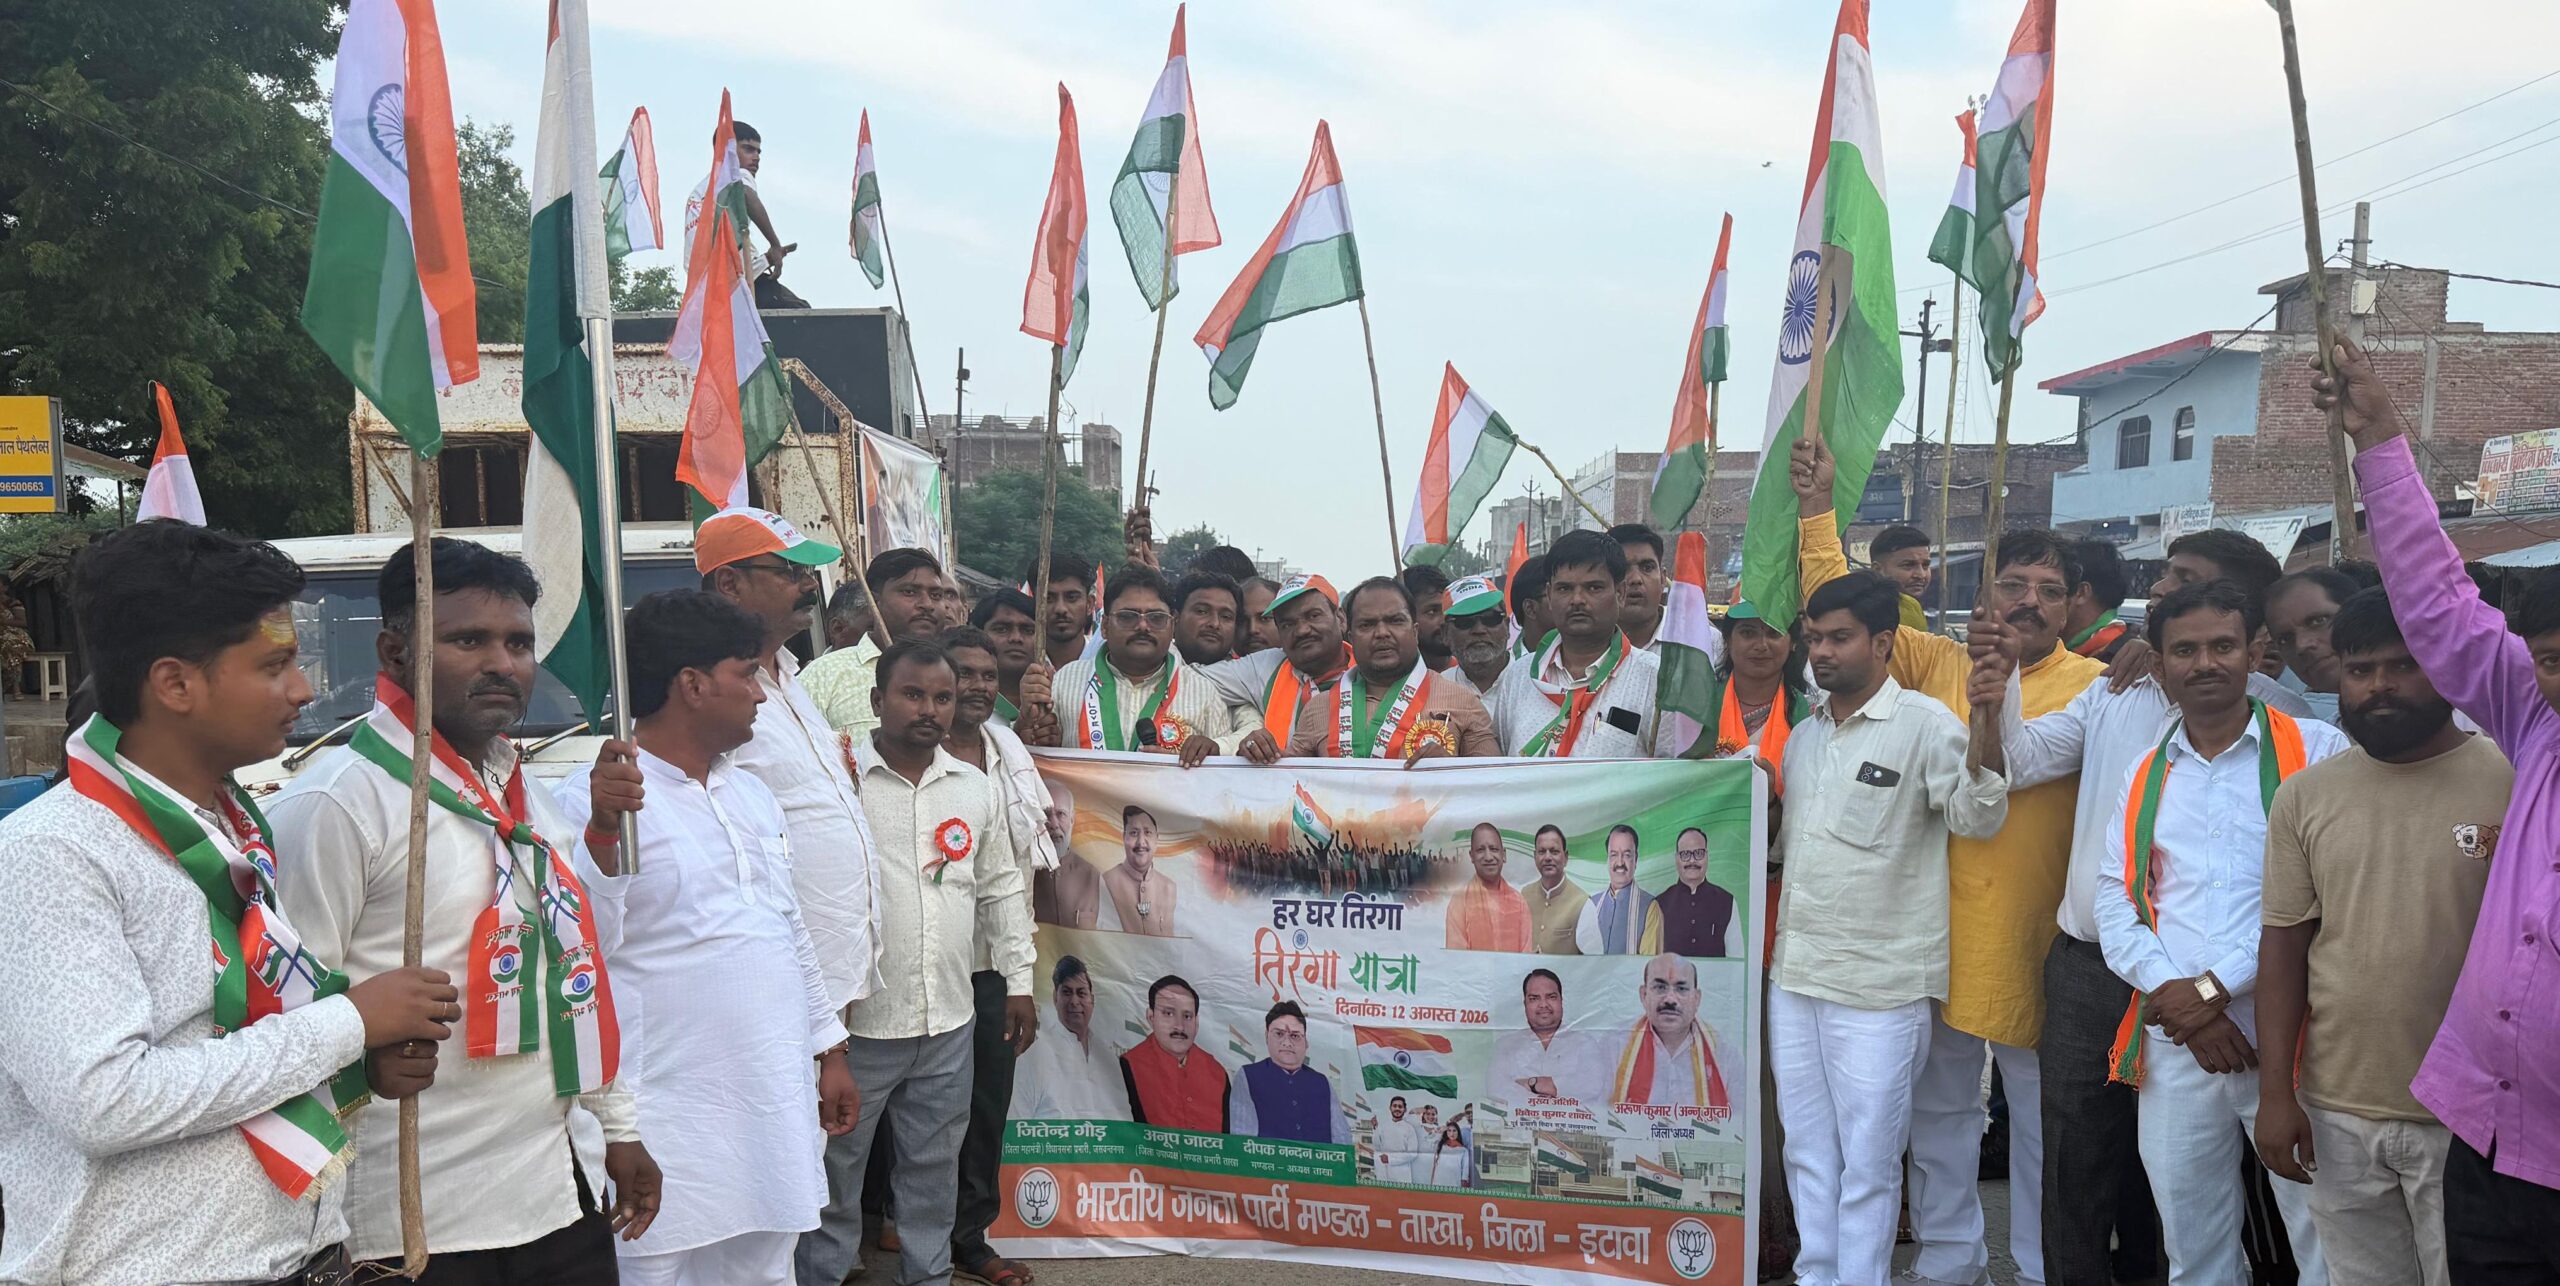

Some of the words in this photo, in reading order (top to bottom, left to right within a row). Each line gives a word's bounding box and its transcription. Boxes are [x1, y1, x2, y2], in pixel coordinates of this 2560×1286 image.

[1272, 899, 1301, 929] हर
[1305, 900, 1337, 928] घर
[1341, 893, 1404, 930] तिरंगा
[1253, 927, 1341, 1006] तिरंगा
[1349, 951, 1420, 994] यात्रा
[1335, 998, 1386, 1018] दिनांक:
[1392, 1005, 1405, 1018] 12
[1409, 1007, 1456, 1022] अगस्त
[1460, 1009, 1488, 1024] 2026
[1527, 1097, 1549, 1106] मुख्य
[1515, 1108, 1539, 1118] विवेक
[1542, 1110, 1567, 1119] कुमार
[1644, 1105, 1671, 1120] कुमार
[1016, 1121, 1070, 1139] जितेन्द्र
[1074, 1121, 1107, 1141] गौड़
[1143, 1129, 1179, 1150] अनूप
[1184, 1134, 1224, 1150] जाटव
[1651, 1124, 1669, 1138] जिला
[1243, 1139, 1276, 1156] दीपक
[1278, 1145, 1313, 1160] नन्दन
[1315, 1149, 1346, 1163] जाटव
[1251, 1160, 1275, 1171] मण्डल
[1287, 1165, 1310, 1175] अध्यक्ष
[1313, 1168, 1333, 1177] ताखा
[1076, 1168, 1164, 1223] भारतीय
[1171, 1184, 1238, 1225] जनता
[1242, 1183, 1289, 1231] पार्टी
[1296, 1199, 1370, 1239] मण्डल
[1480, 1202, 1546, 1253] जिला
[1577, 1222, 1651, 1265] इटावा
